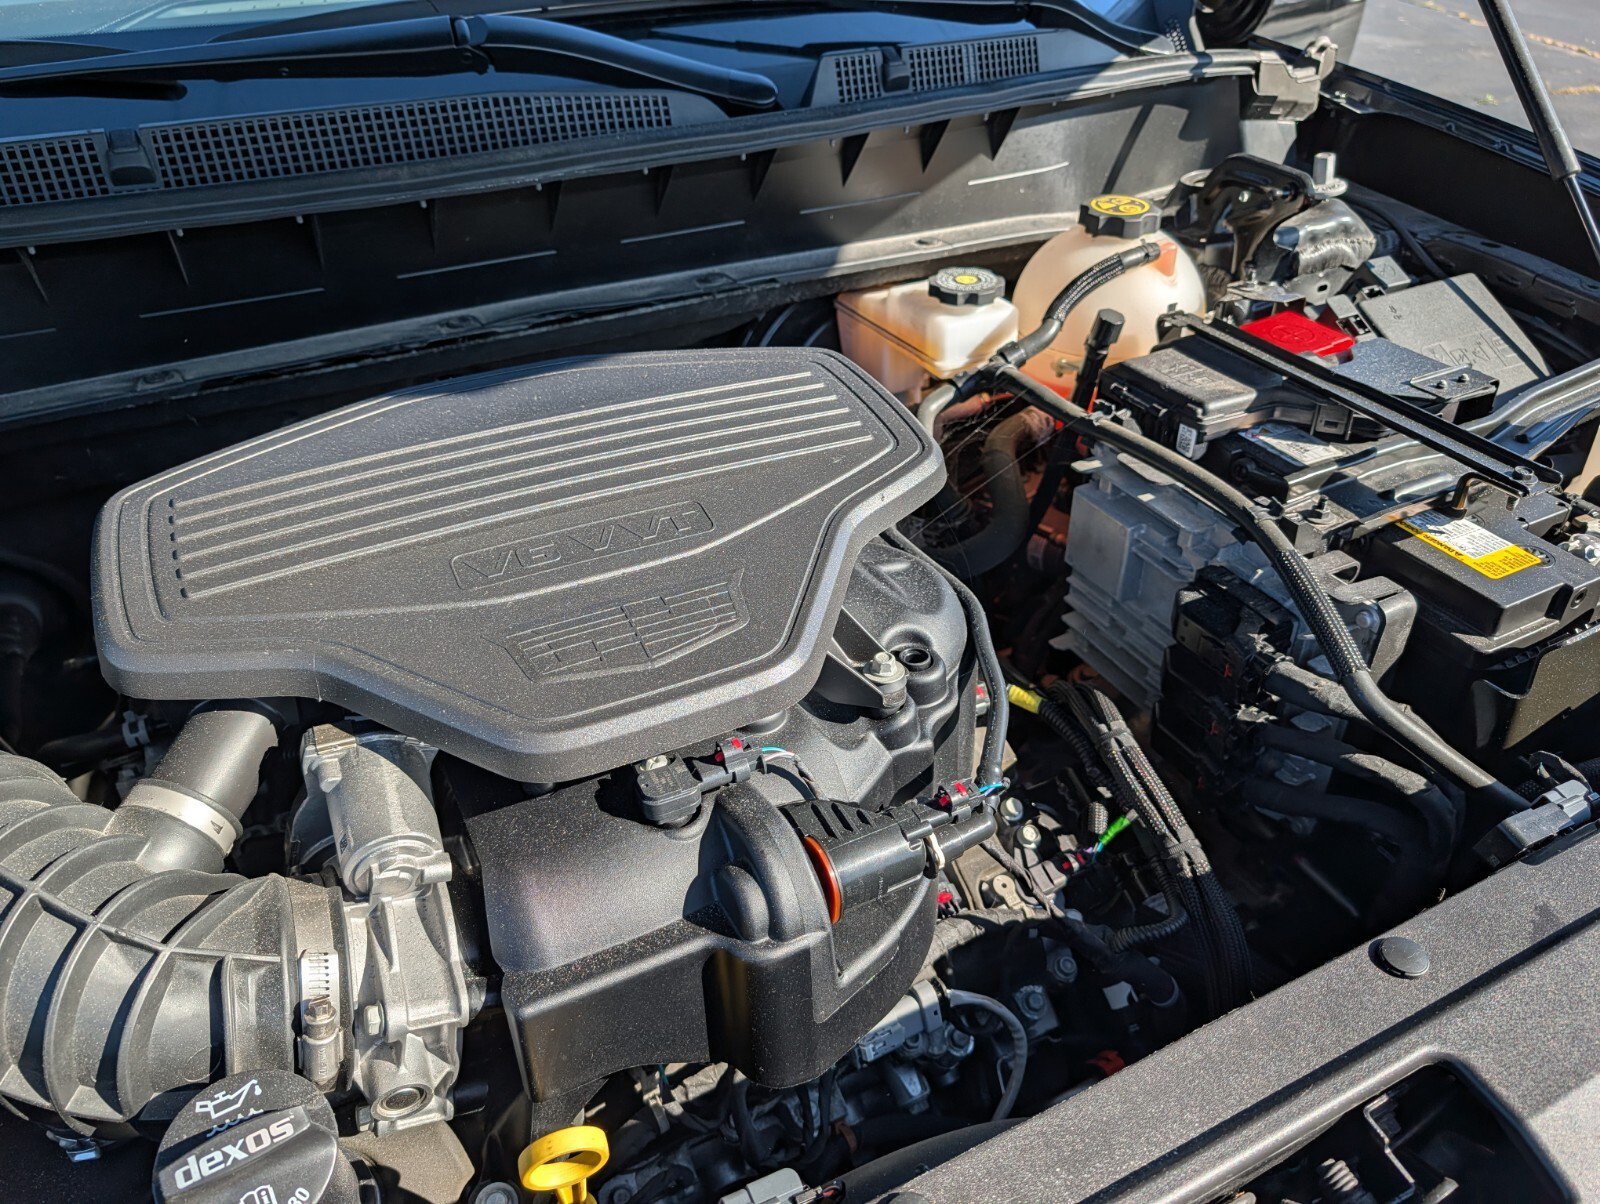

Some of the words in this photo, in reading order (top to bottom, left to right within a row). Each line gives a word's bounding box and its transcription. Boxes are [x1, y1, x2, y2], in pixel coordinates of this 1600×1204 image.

[462, 543, 562, 578] V6
[567, 510, 697, 552] VVT
[174, 1116, 295, 1190] dexos
